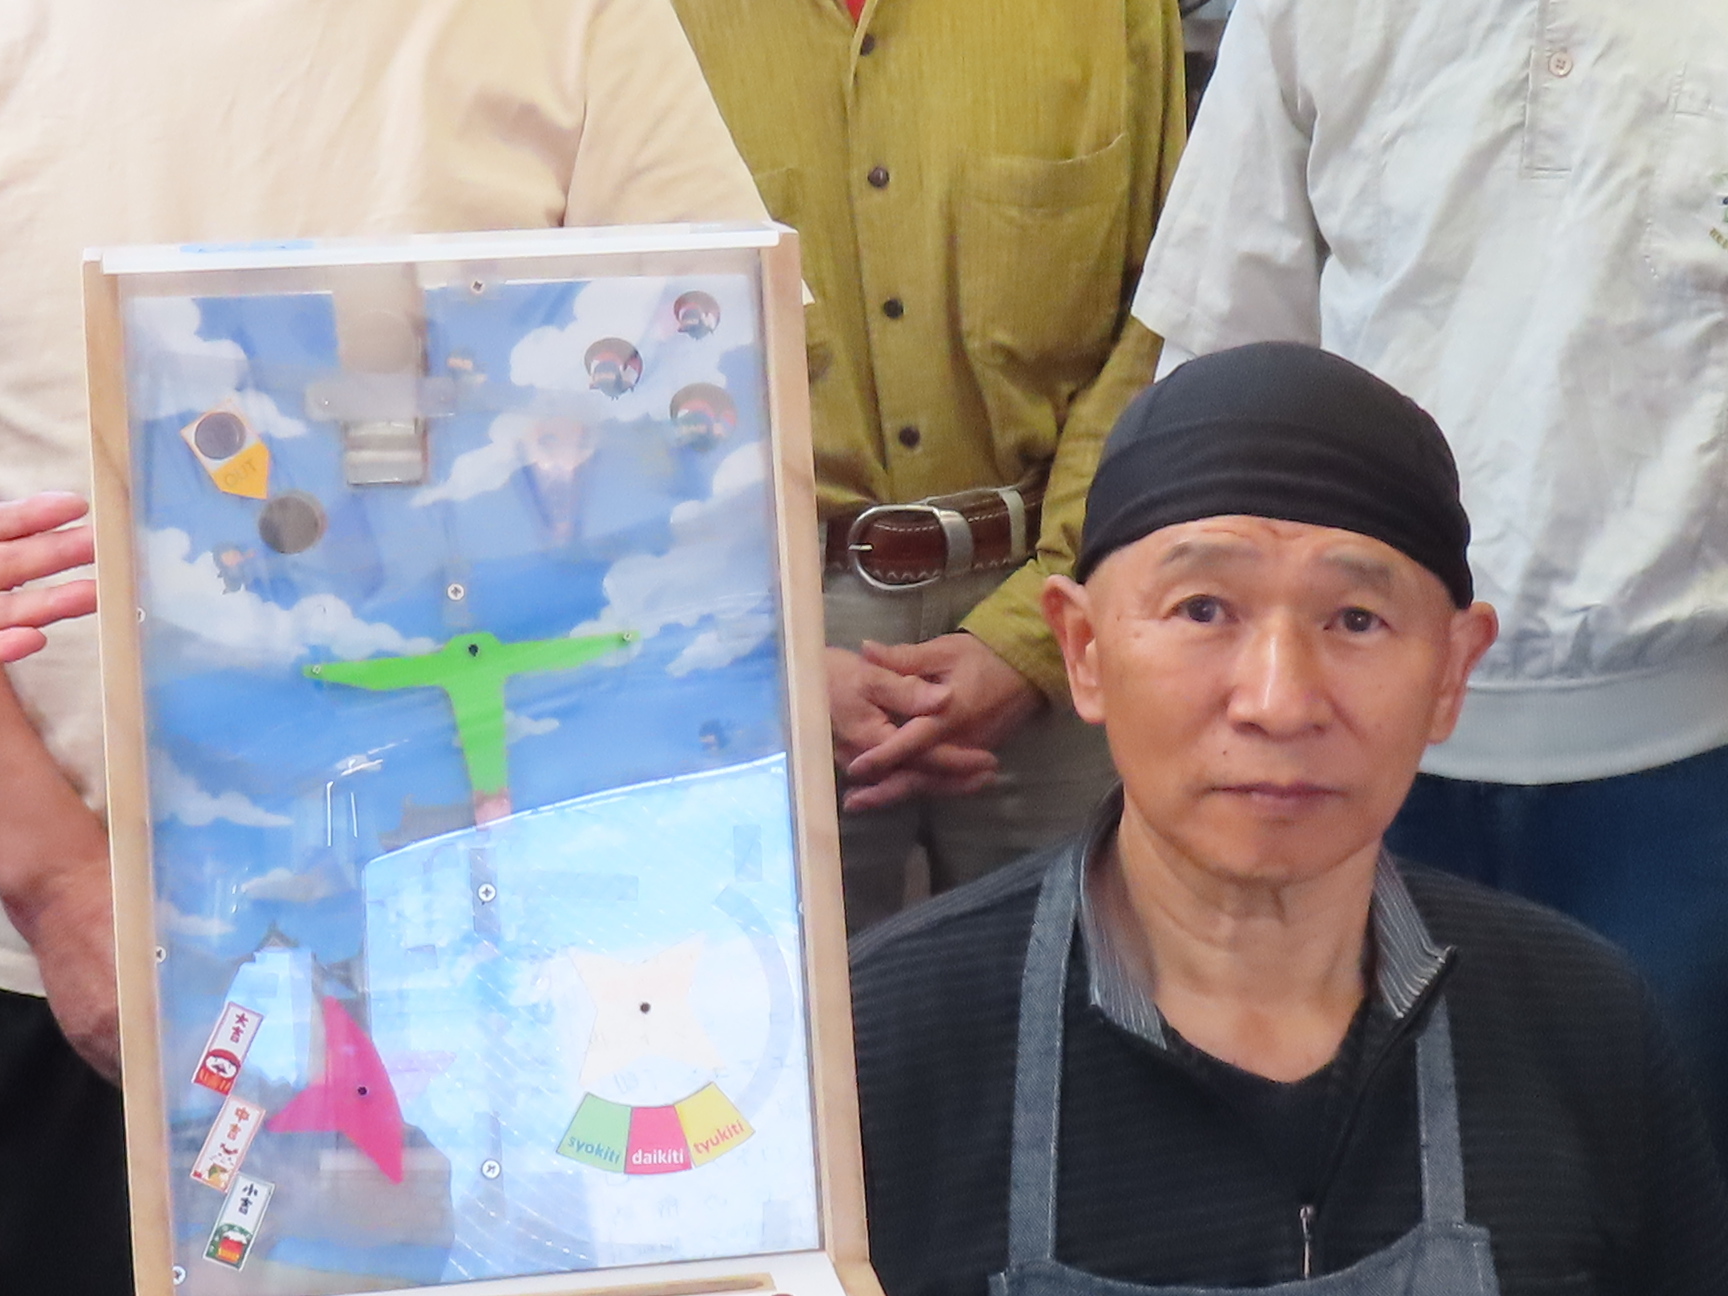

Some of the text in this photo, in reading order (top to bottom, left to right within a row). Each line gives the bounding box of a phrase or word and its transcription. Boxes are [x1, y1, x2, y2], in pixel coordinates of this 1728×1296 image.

[230, 1012, 249, 1044] 大吉
[226, 1106, 251, 1141] 中吉
[568, 1118, 746, 1165] syokiti daikiti tyukiti
[239, 1184, 258, 1215] 小吉
